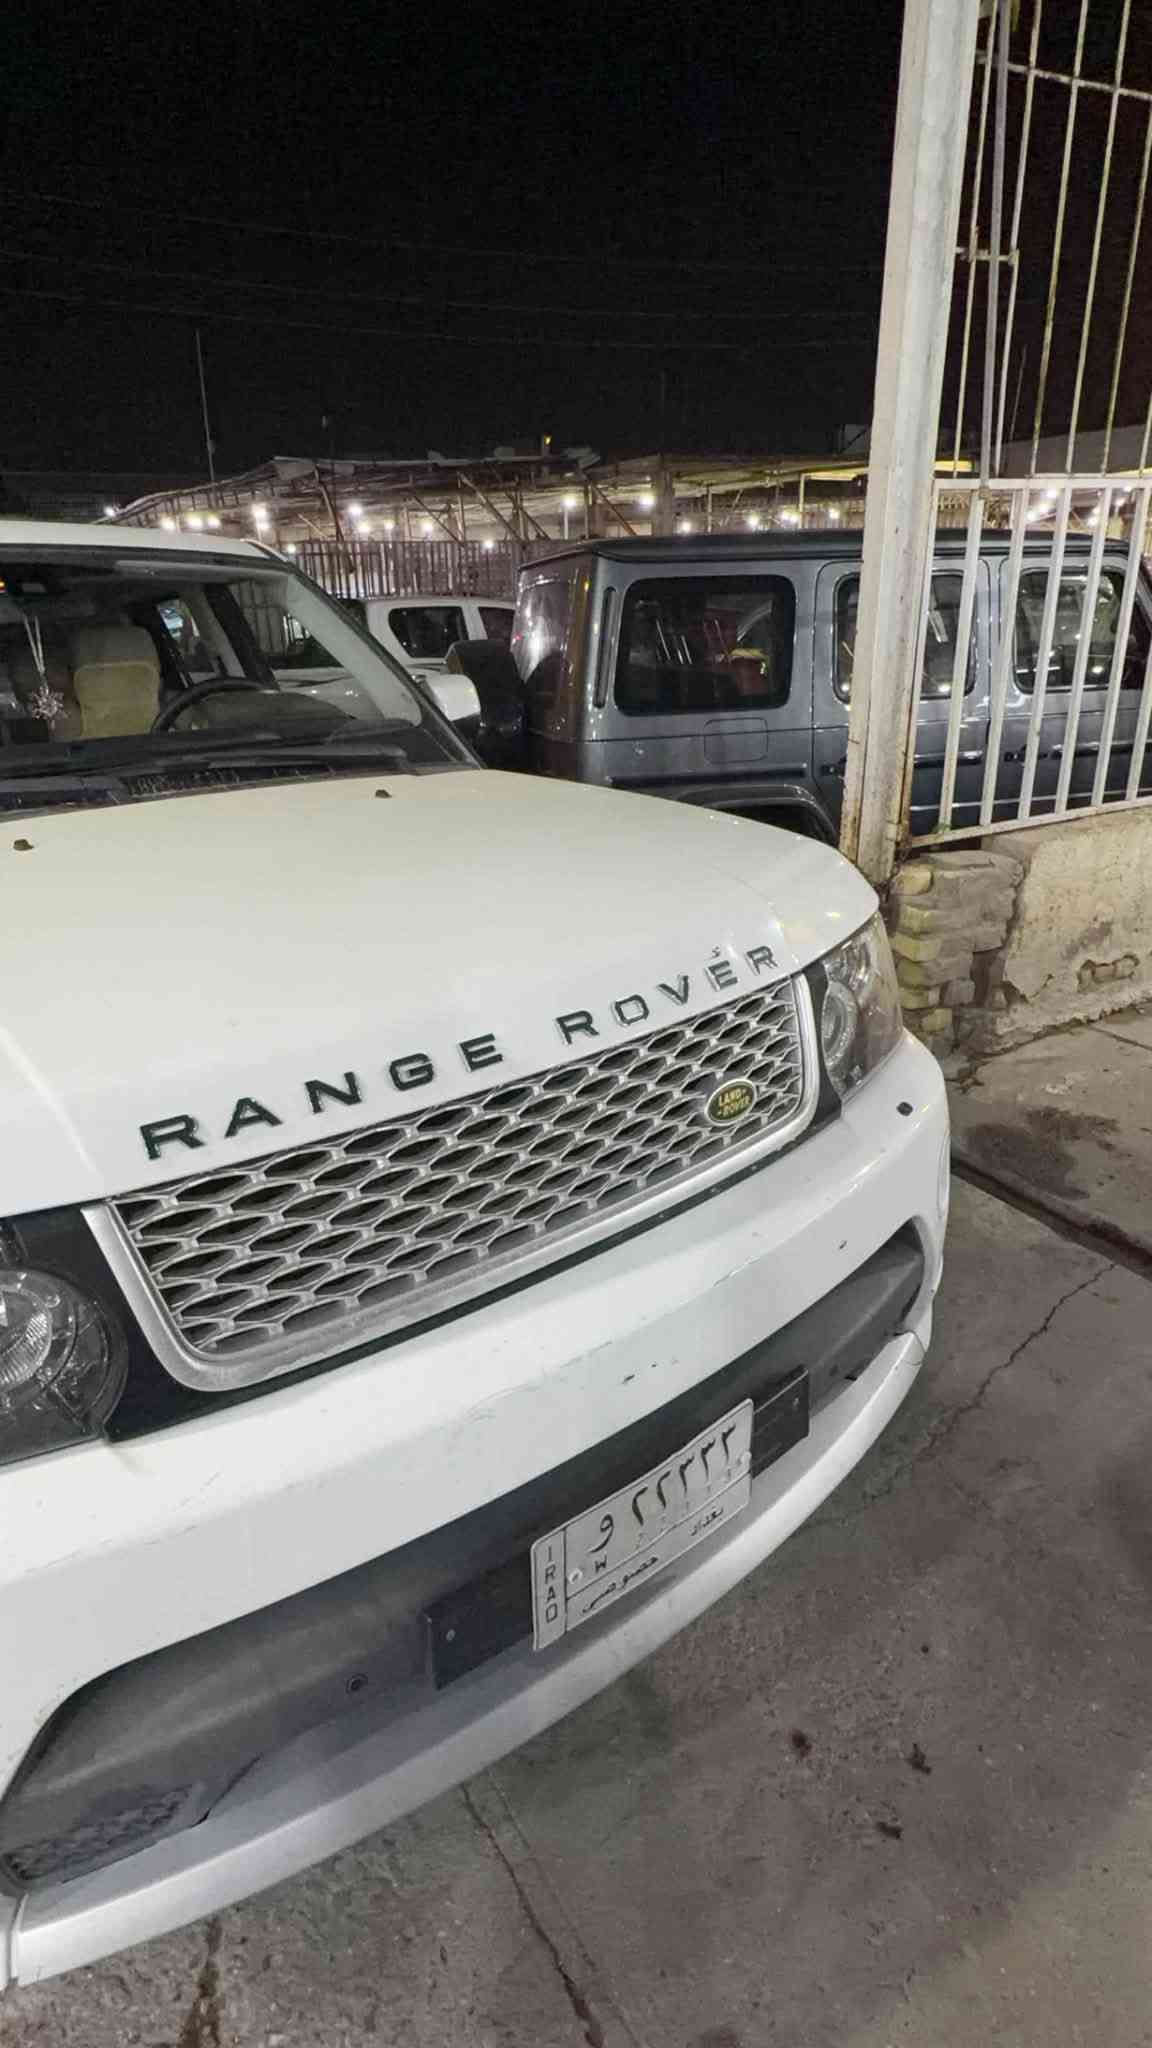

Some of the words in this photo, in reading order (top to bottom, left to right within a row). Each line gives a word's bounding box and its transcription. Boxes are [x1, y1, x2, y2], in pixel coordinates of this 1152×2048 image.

[139, 1032, 504, 1160] RANGE
[555, 946, 778, 1045] ROVER
[719, 1087, 743, 1107] LAND
[722, 1095, 751, 1117] ROVER
